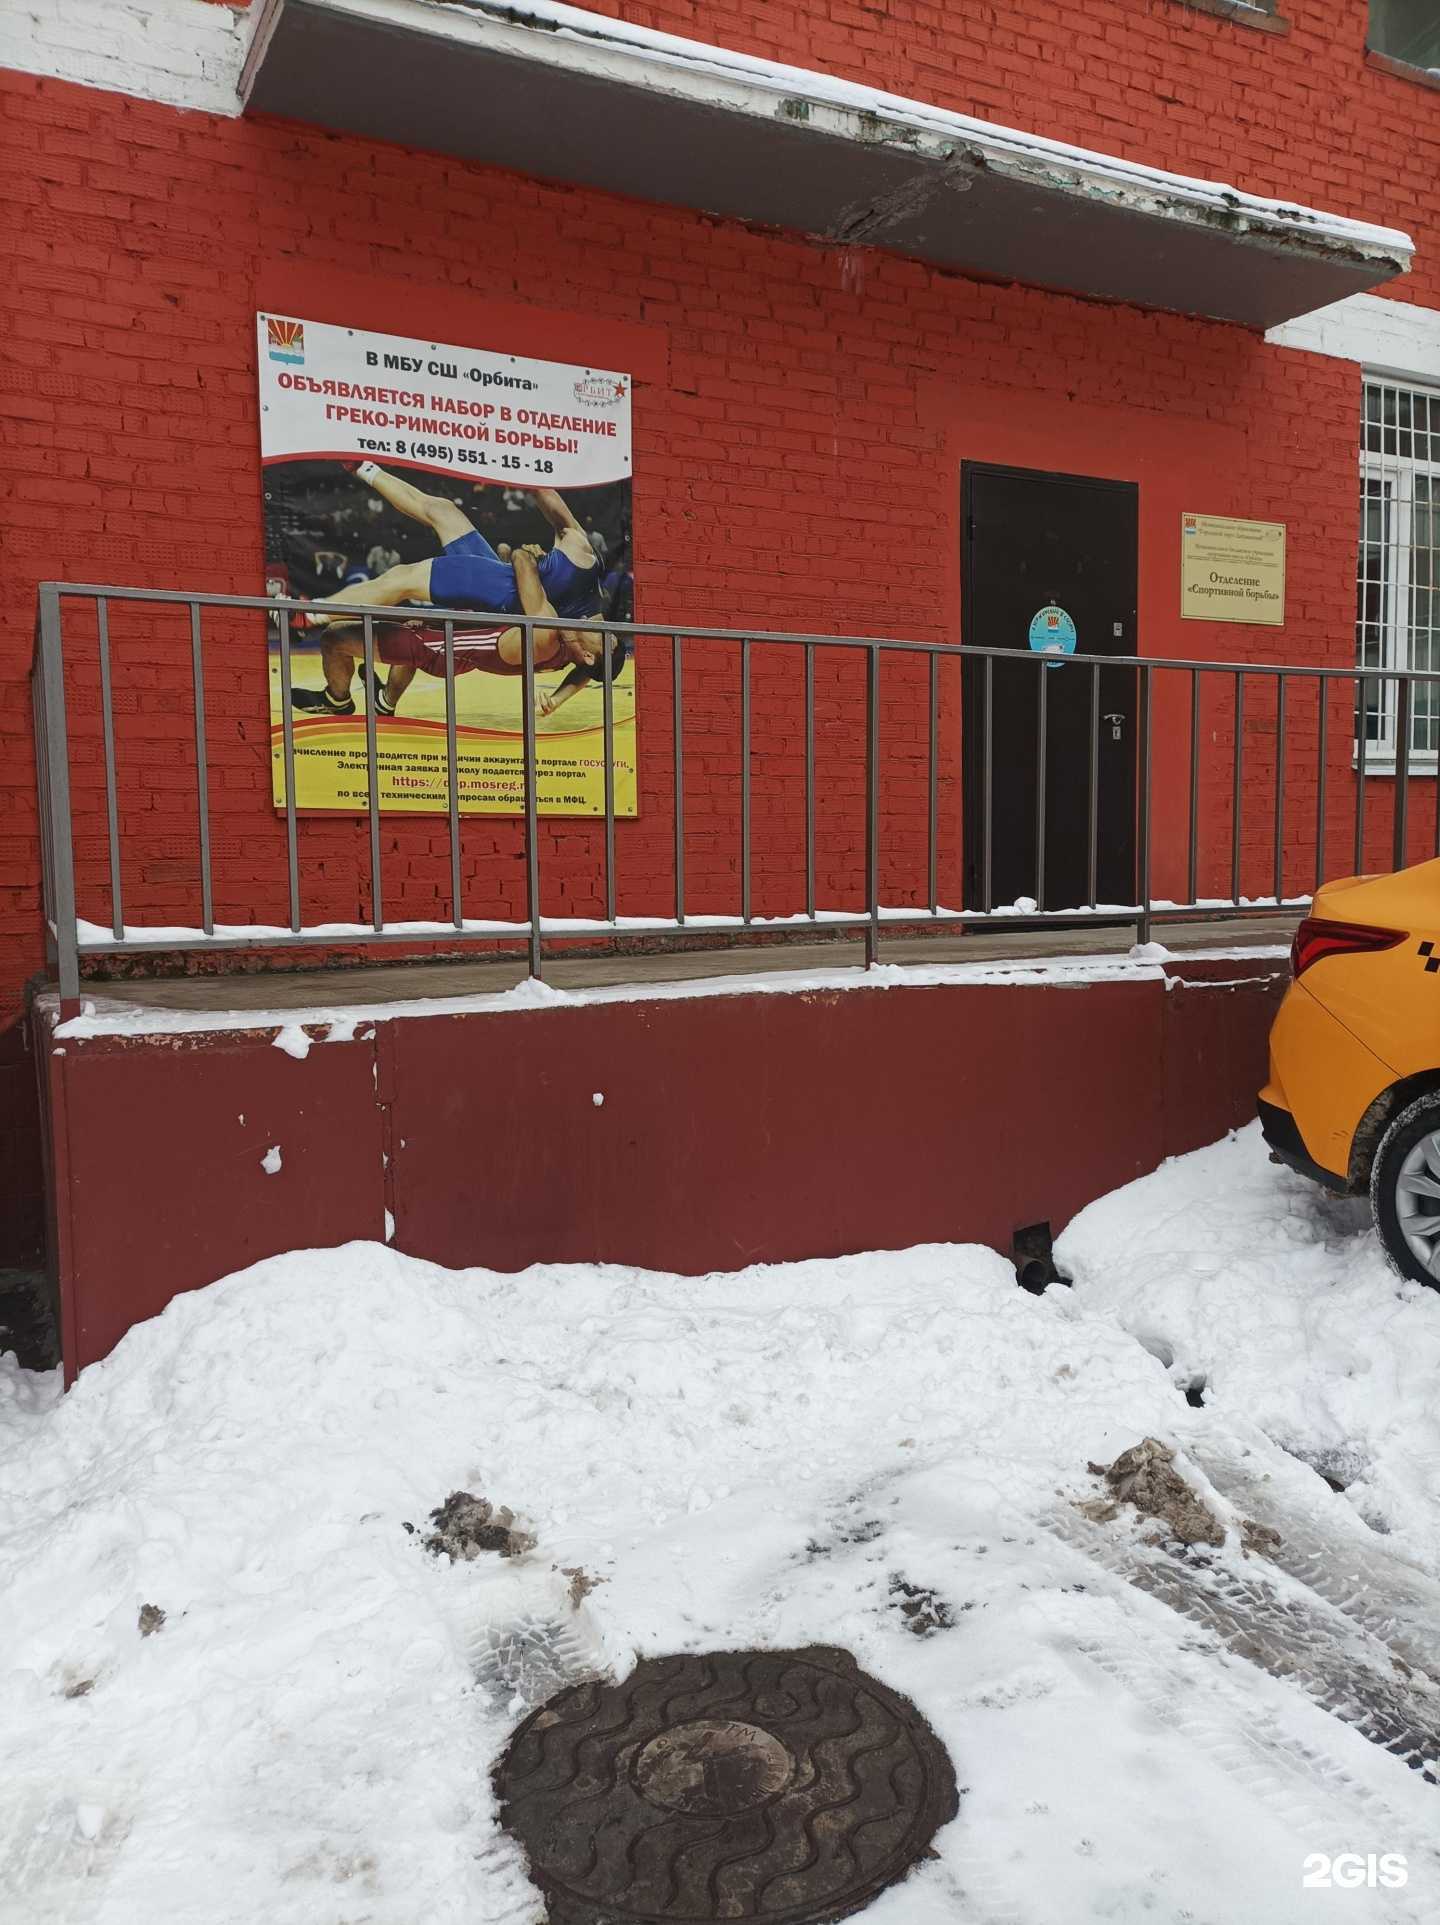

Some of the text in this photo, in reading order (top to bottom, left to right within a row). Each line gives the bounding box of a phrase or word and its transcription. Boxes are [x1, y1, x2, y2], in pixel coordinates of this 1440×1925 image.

[366, 350, 539, 391] В МБУ СШ «Орбита»
[277, 372, 617, 437] ОБЪЯВЛЯЕТСЯ НАБОР В ОТДЕЛЕНИЕ
[325, 403, 579, 454] ГРЕКО-РИМСКОЙ БОРЬБЫ!
[357, 437, 391, 453] тел:
[395, 440, 407, 454] 8
[409, 443, 454, 463] (495)
[457, 449, 489, 466] 551
[500, 455, 521, 469] 15
[534, 459, 554, 474] 18
[1209, 571, 1260, 586] Отделение
[405, 764, 440, 773] заявка
[556, 770, 586, 779] портал
[420, 753, 439, 762] при
[541, 760, 577, 768] портале
[337, 790, 350, 798] по
[381, 792, 446, 801] техническим
